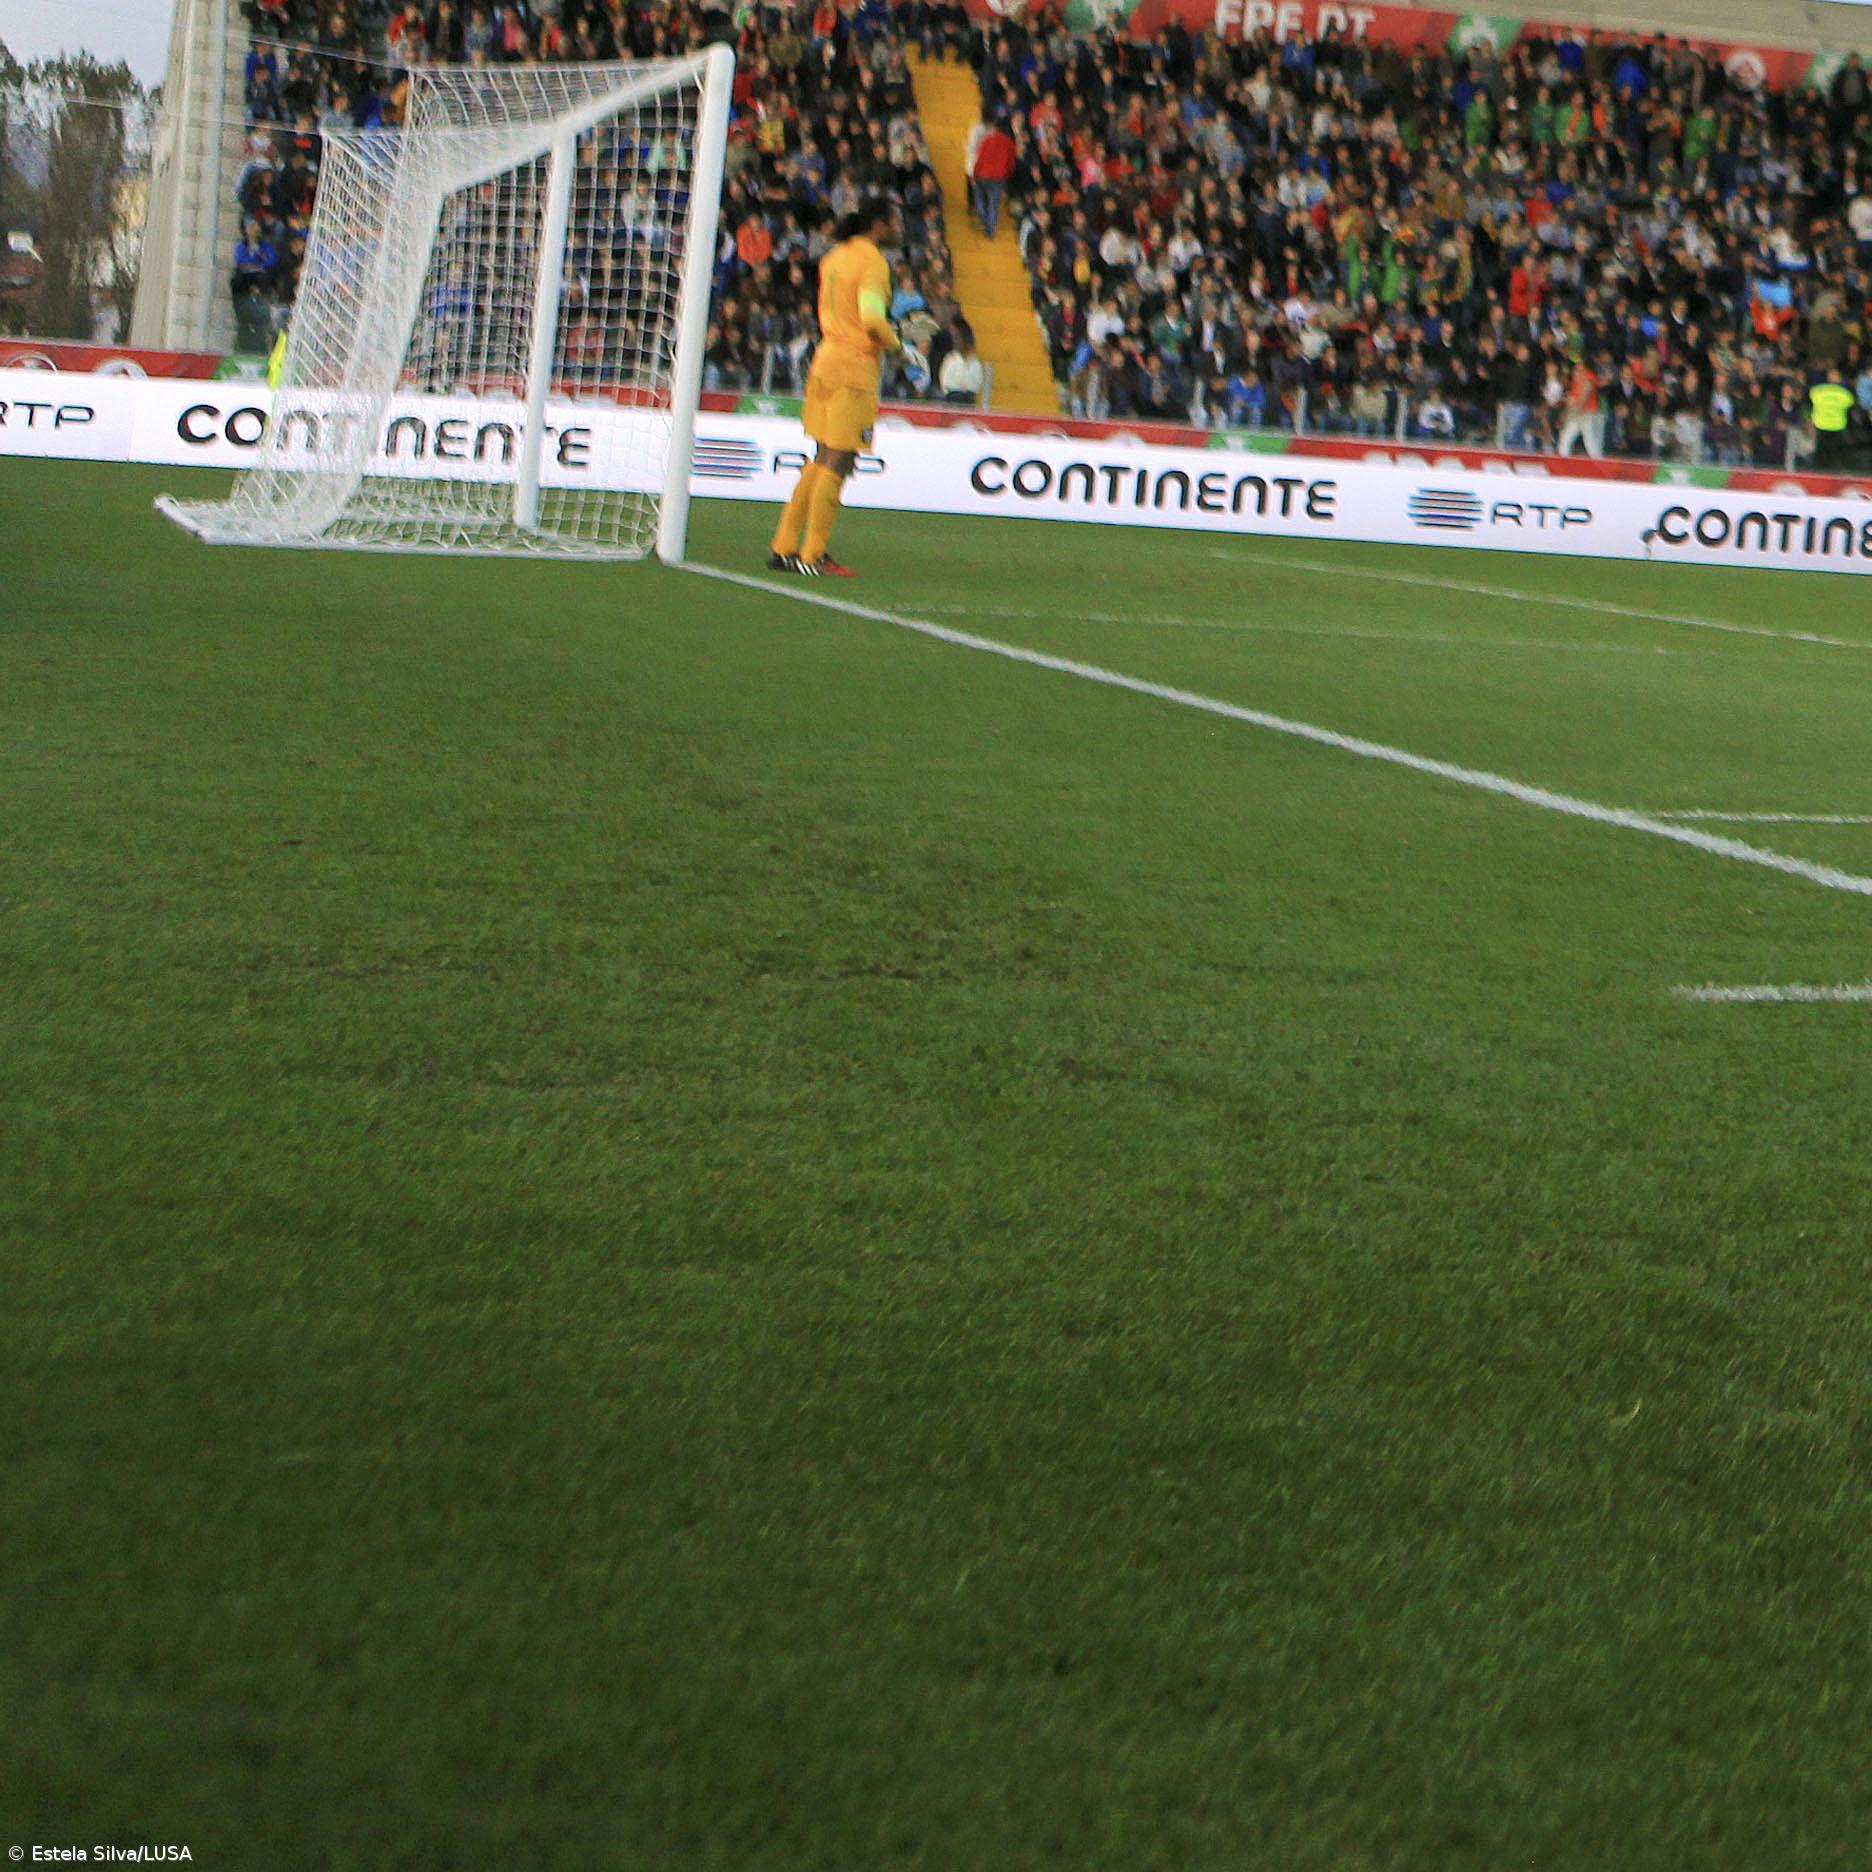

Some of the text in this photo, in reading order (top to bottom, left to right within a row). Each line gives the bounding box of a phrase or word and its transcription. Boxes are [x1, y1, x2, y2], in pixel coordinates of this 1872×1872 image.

[177, 403, 595, 471] CONTNENE
[970, 456, 1338, 521] CONTINENTE
[1490, 500, 1593, 530] RTP
